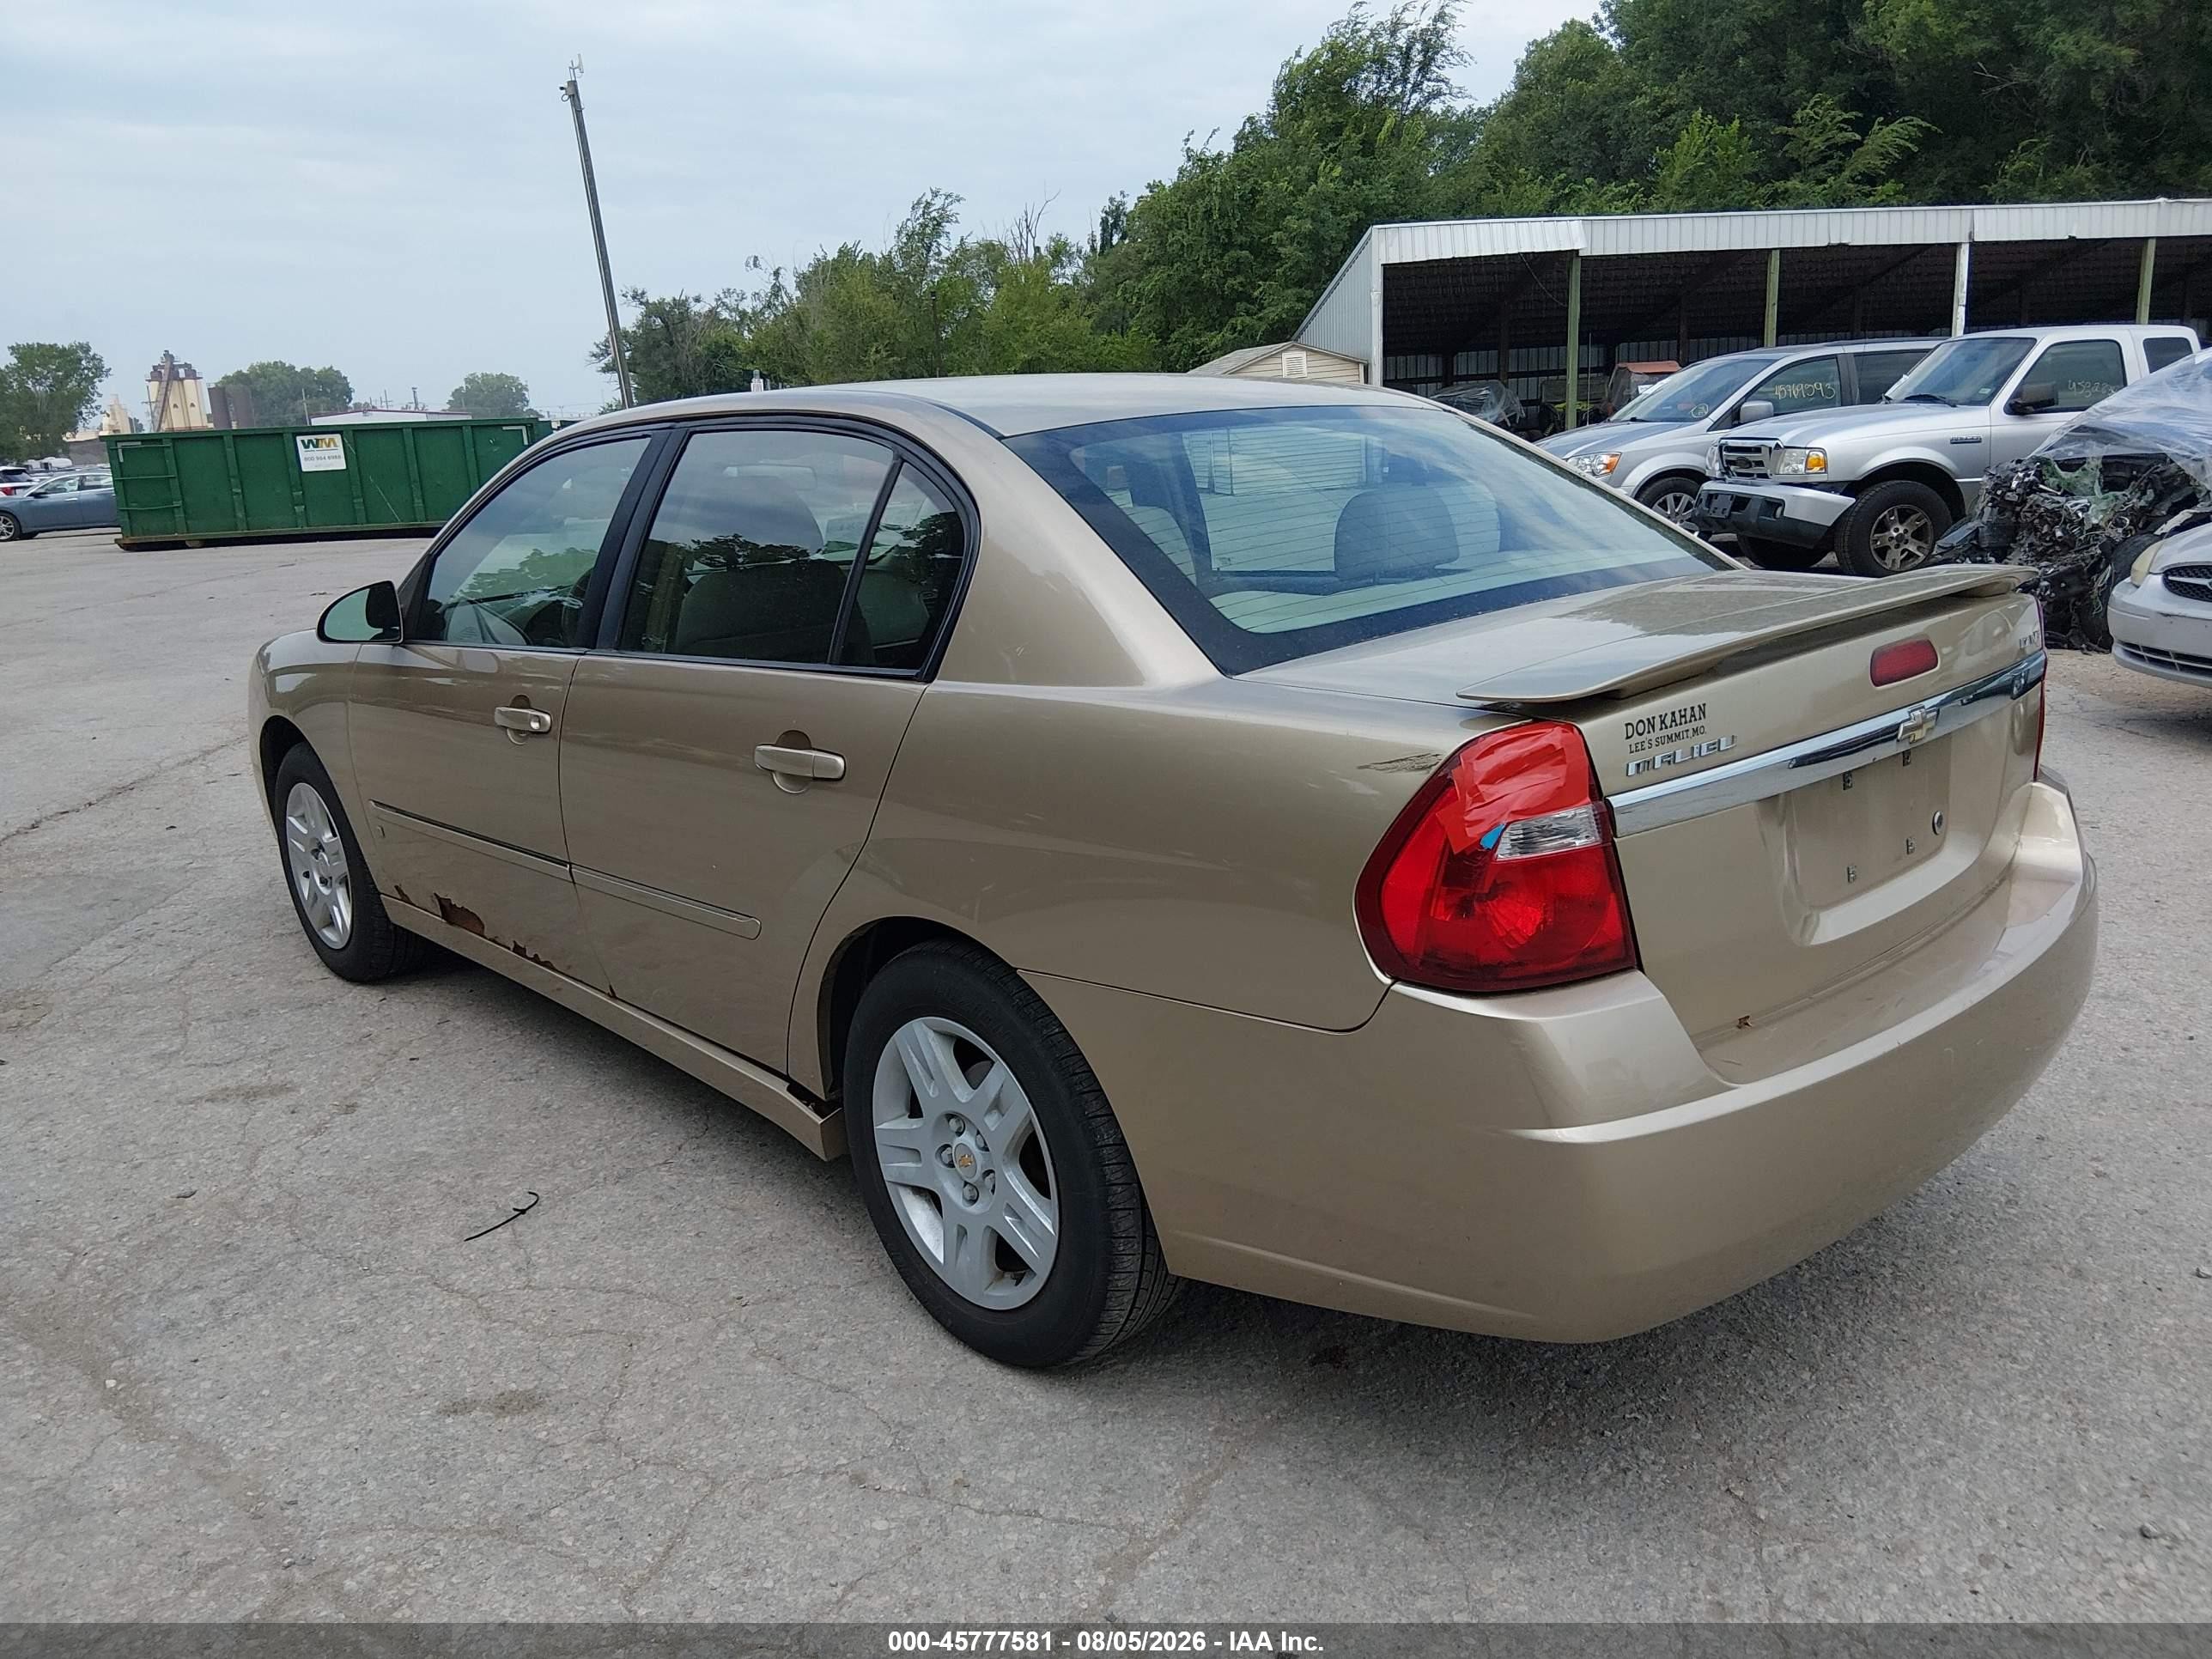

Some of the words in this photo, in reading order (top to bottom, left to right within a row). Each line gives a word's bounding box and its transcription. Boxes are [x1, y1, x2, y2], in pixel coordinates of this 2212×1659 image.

[1625, 716, 1656, 739] DON
[1658, 703, 1706, 731] KAHAN
[1628, 738, 1653, 754] LEE'S
